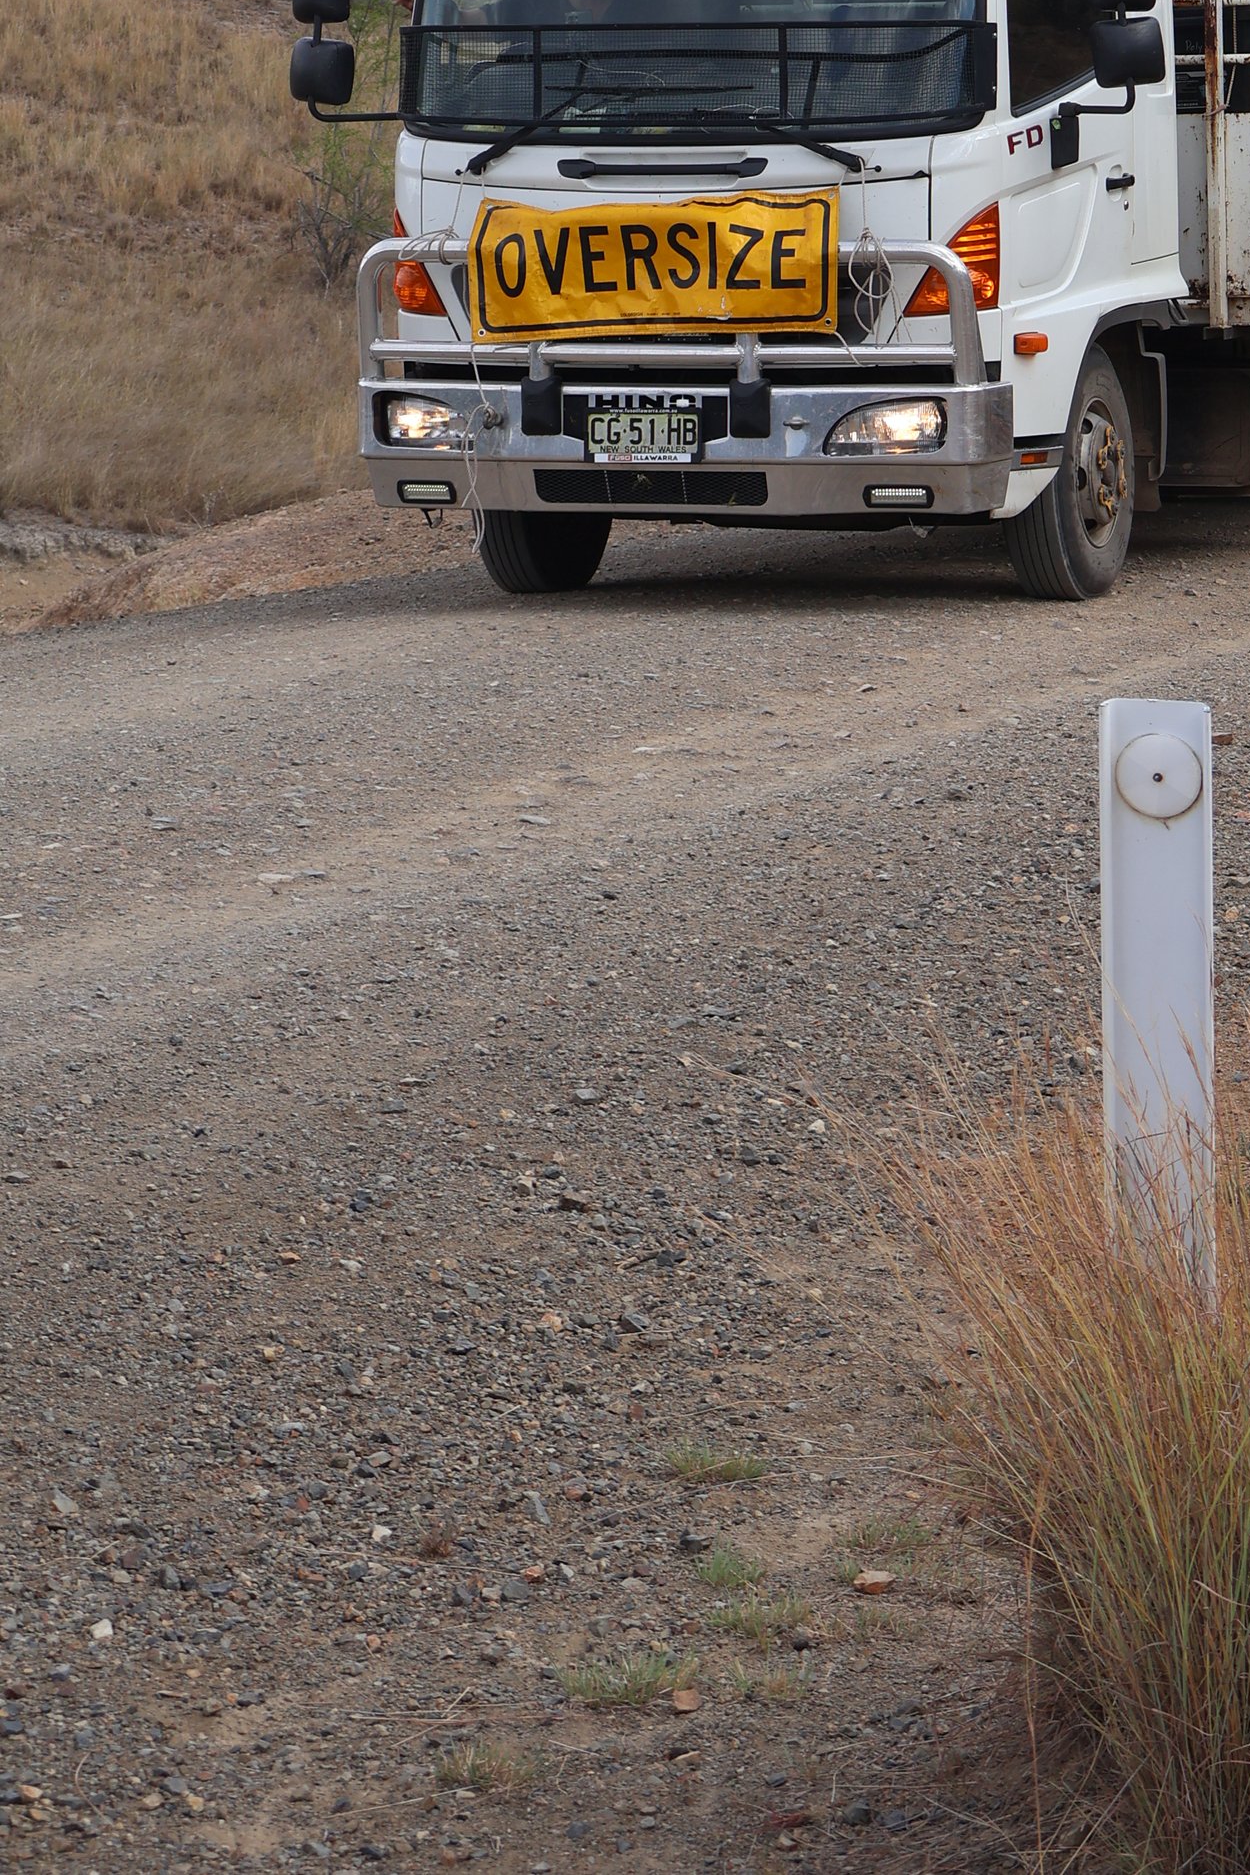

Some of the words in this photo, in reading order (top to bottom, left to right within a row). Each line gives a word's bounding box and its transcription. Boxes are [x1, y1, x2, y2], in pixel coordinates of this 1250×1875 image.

[1006, 124, 1044, 156] FD
[494, 221, 807, 298] OVERSIZE
[600, 445, 620, 454] NEW
[624, 445, 654, 454] SOUTH
[657, 445, 687, 454] WALES
